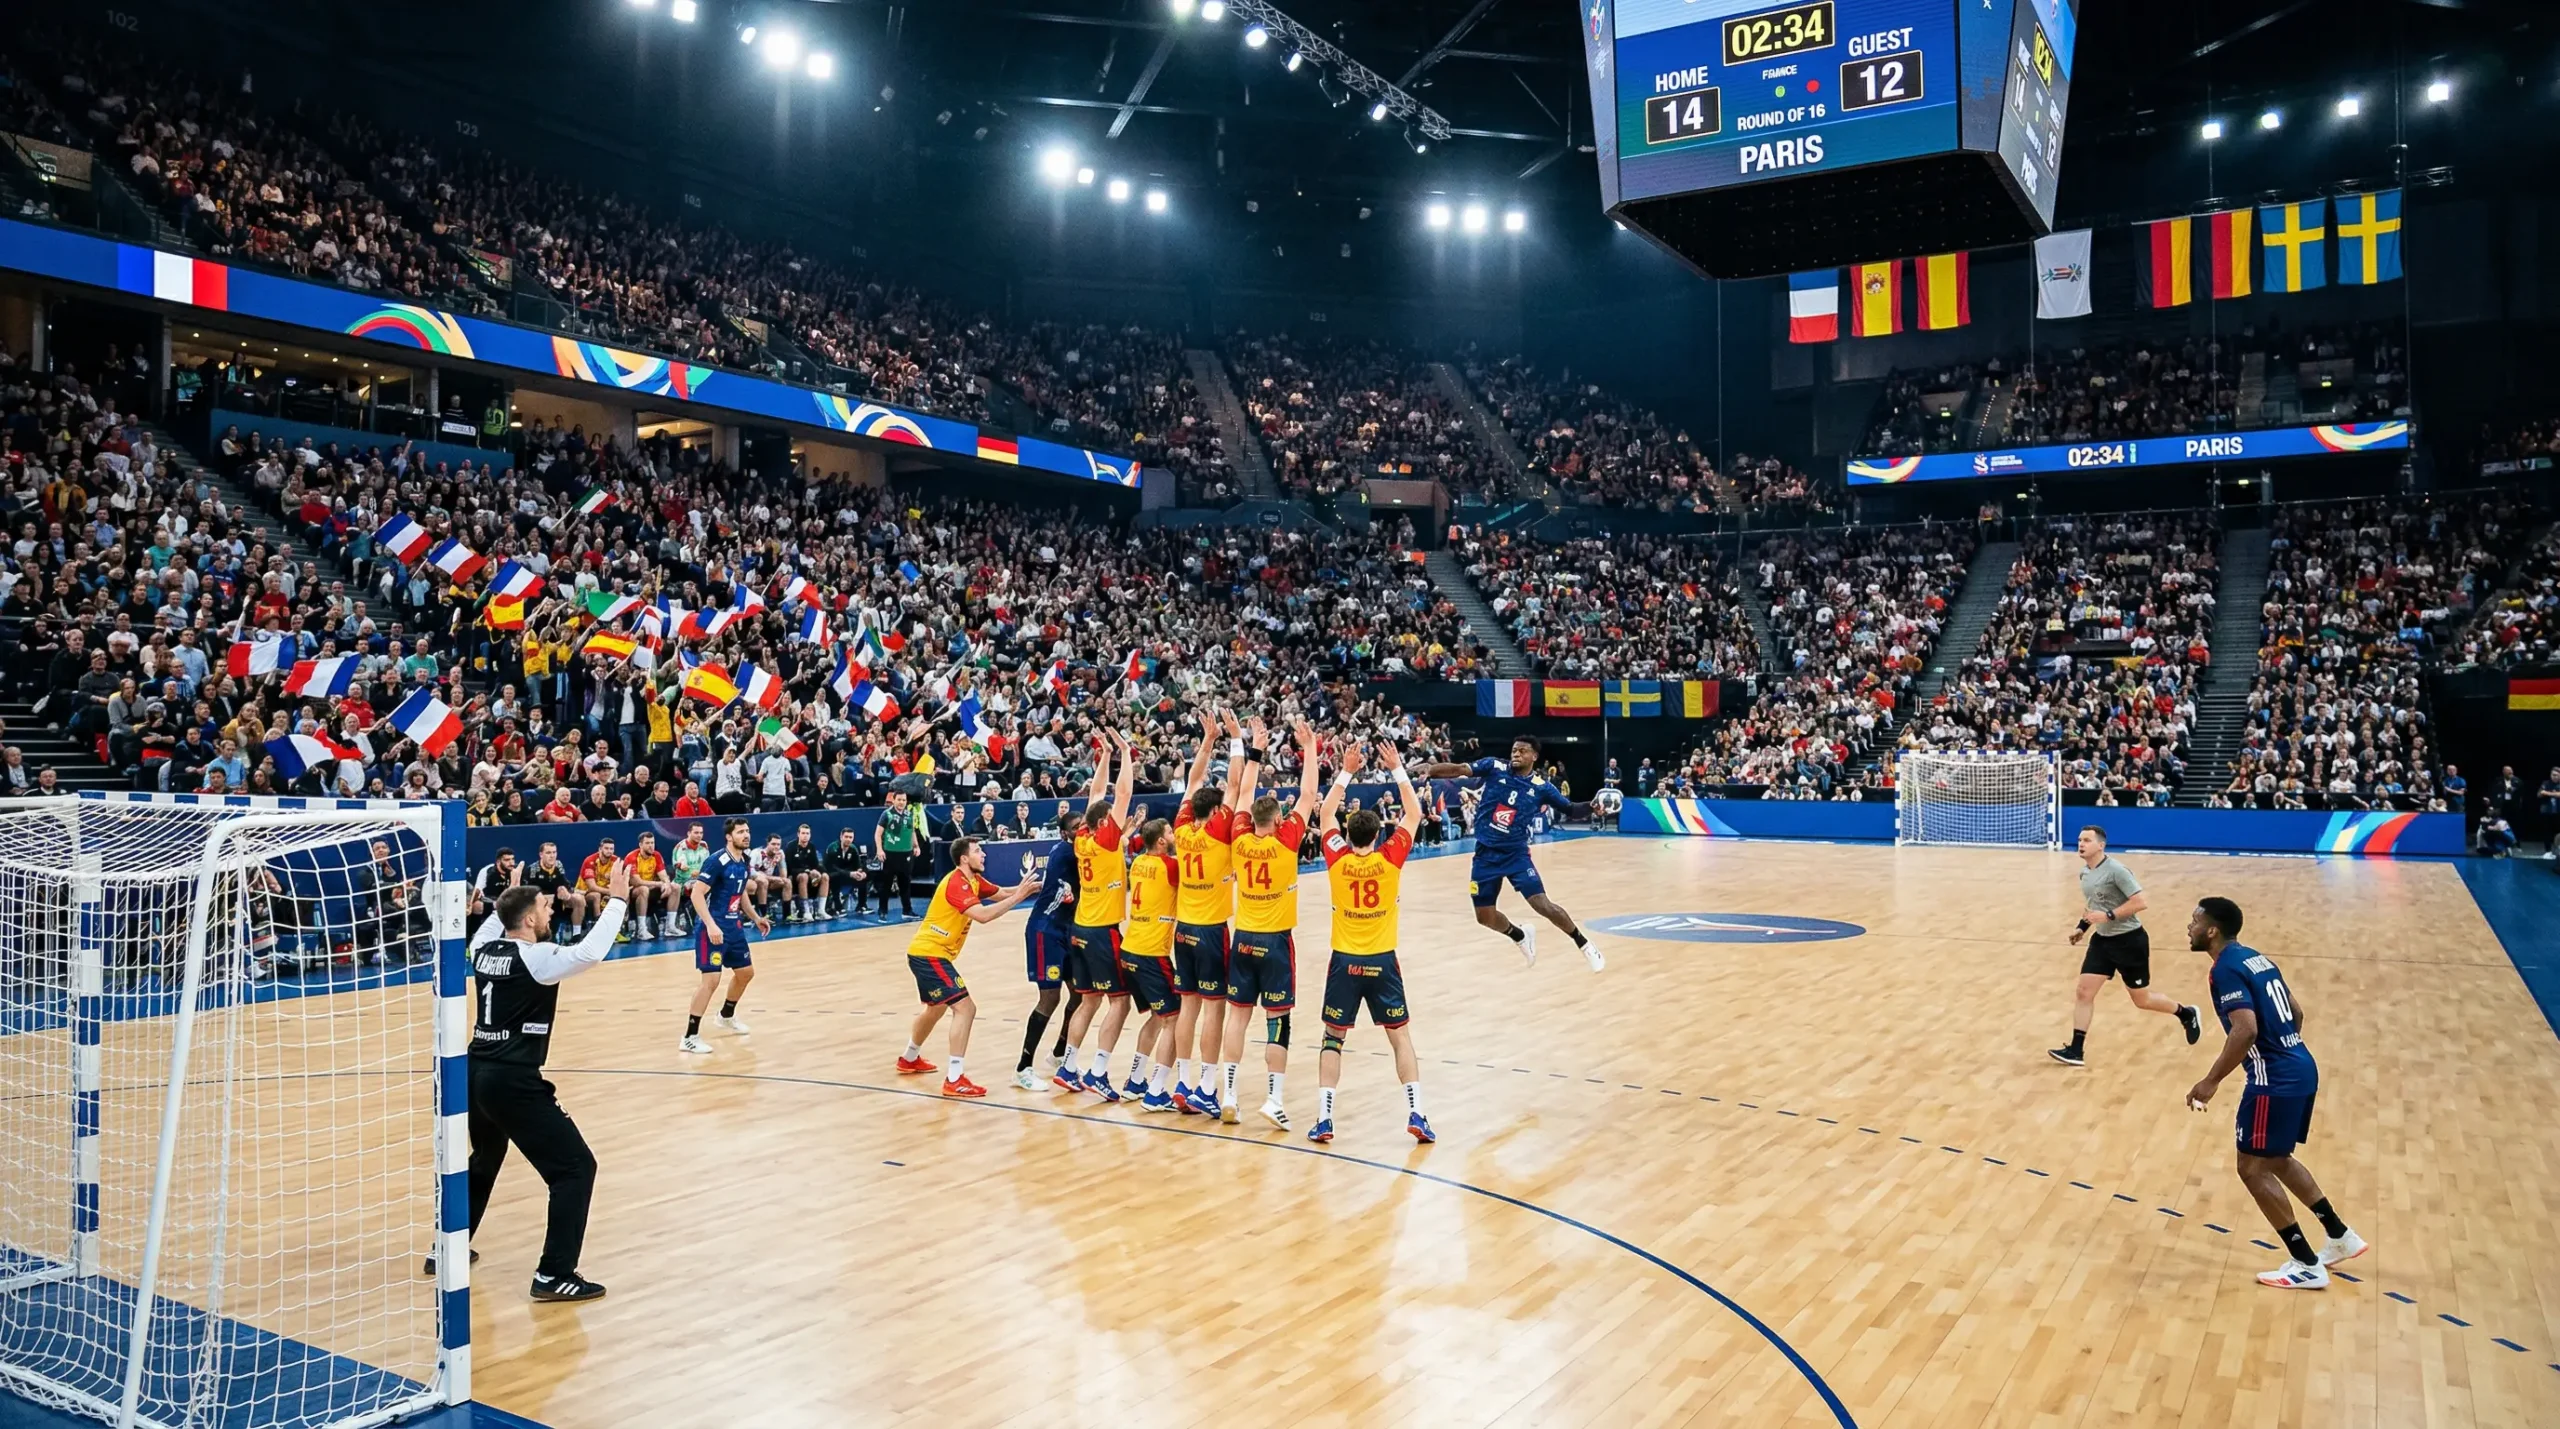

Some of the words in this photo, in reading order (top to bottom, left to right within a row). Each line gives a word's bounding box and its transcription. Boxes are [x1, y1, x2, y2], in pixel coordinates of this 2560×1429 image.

[1732, 9, 1825, 57] 02:34
[1849, 27, 1914, 57] GUEST
[1655, 65, 1709, 93] HOME
[1859, 61, 1905, 101] 12
[1662, 96, 1705, 135] 14
[1737, 110, 1785, 131] ROUND
[1787, 106, 1806, 123] OF
[1808, 103, 1826, 119] 16
[1740, 134, 1825, 174] PARIS
[2068, 445, 2125, 467] 02:34
[2186, 437, 2244, 458] PARIS
[1507, 790, 1518, 806] 8
[1183, 852, 1205, 880] 11
[1244, 860, 1272, 890] 14
[736, 879, 744, 894] 7
[1132, 881, 1143, 910] 4
[1349, 879, 1380, 909] 18
[482, 980, 494, 1025] 1
[2265, 978, 2293, 1024] 10
